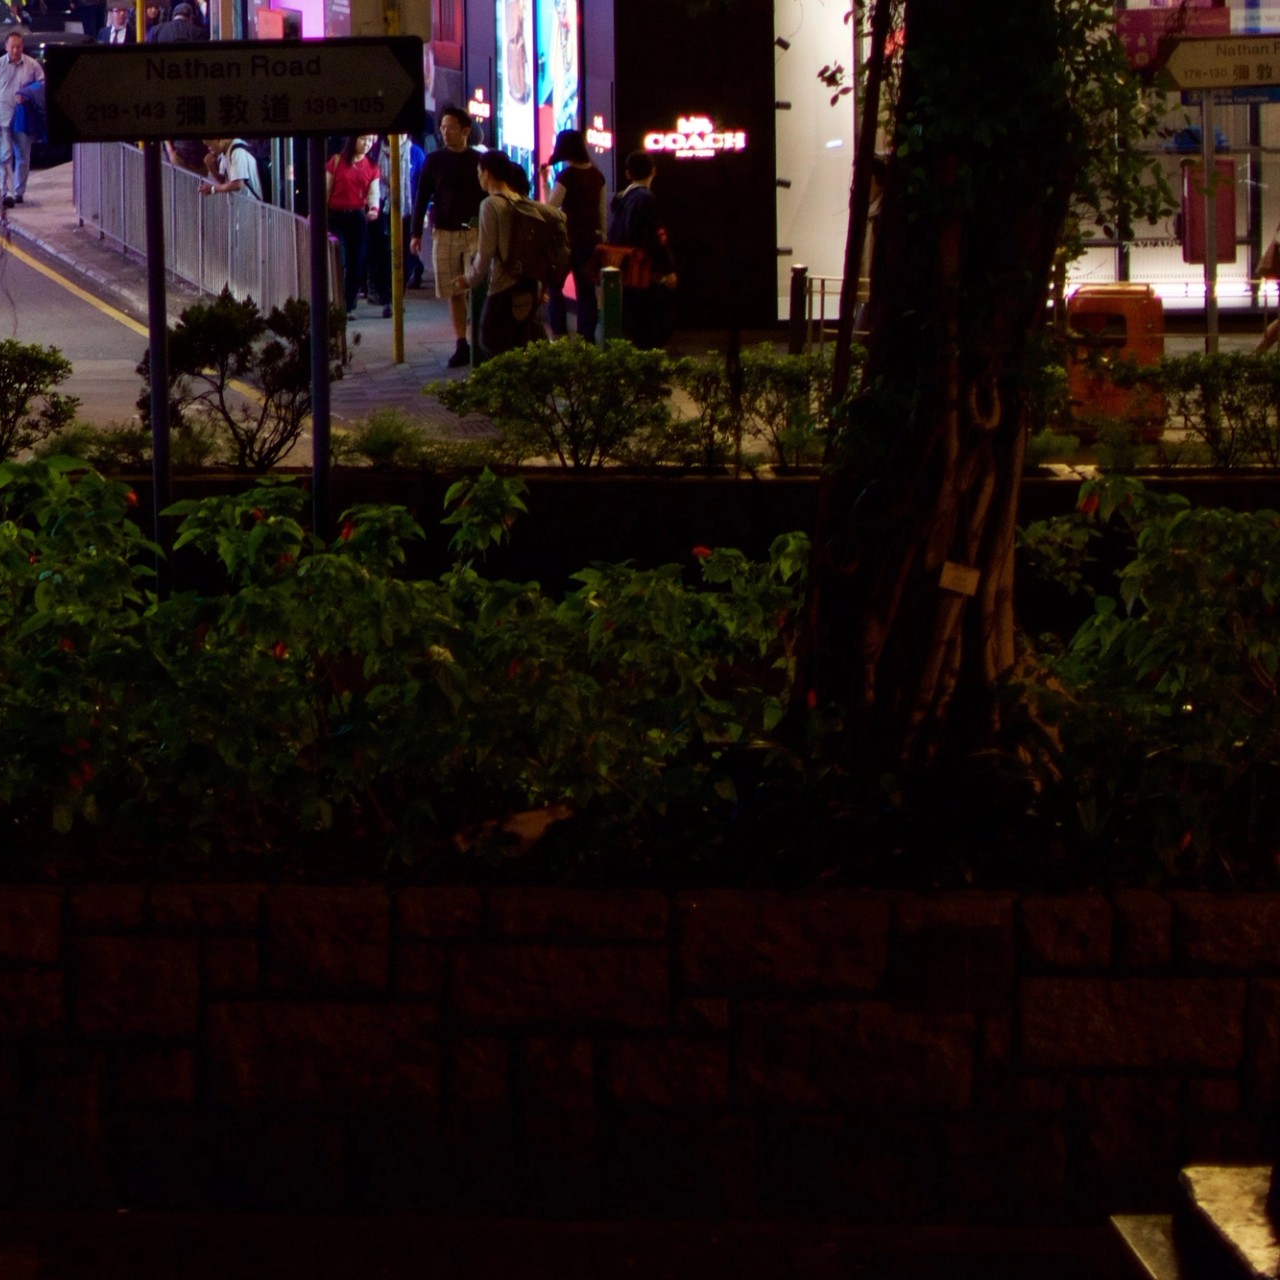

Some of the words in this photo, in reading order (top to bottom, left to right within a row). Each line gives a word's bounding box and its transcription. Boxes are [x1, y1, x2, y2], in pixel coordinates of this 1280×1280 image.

[1216, 43, 1269, 57] Nathan
[145, 57, 241, 81] Nathan
[251, 55, 321, 79] Road
[175, 93, 292, 126] 彌敦道
[304, 95, 385, 115] 139-105
[643, 131, 746, 151] COACH
